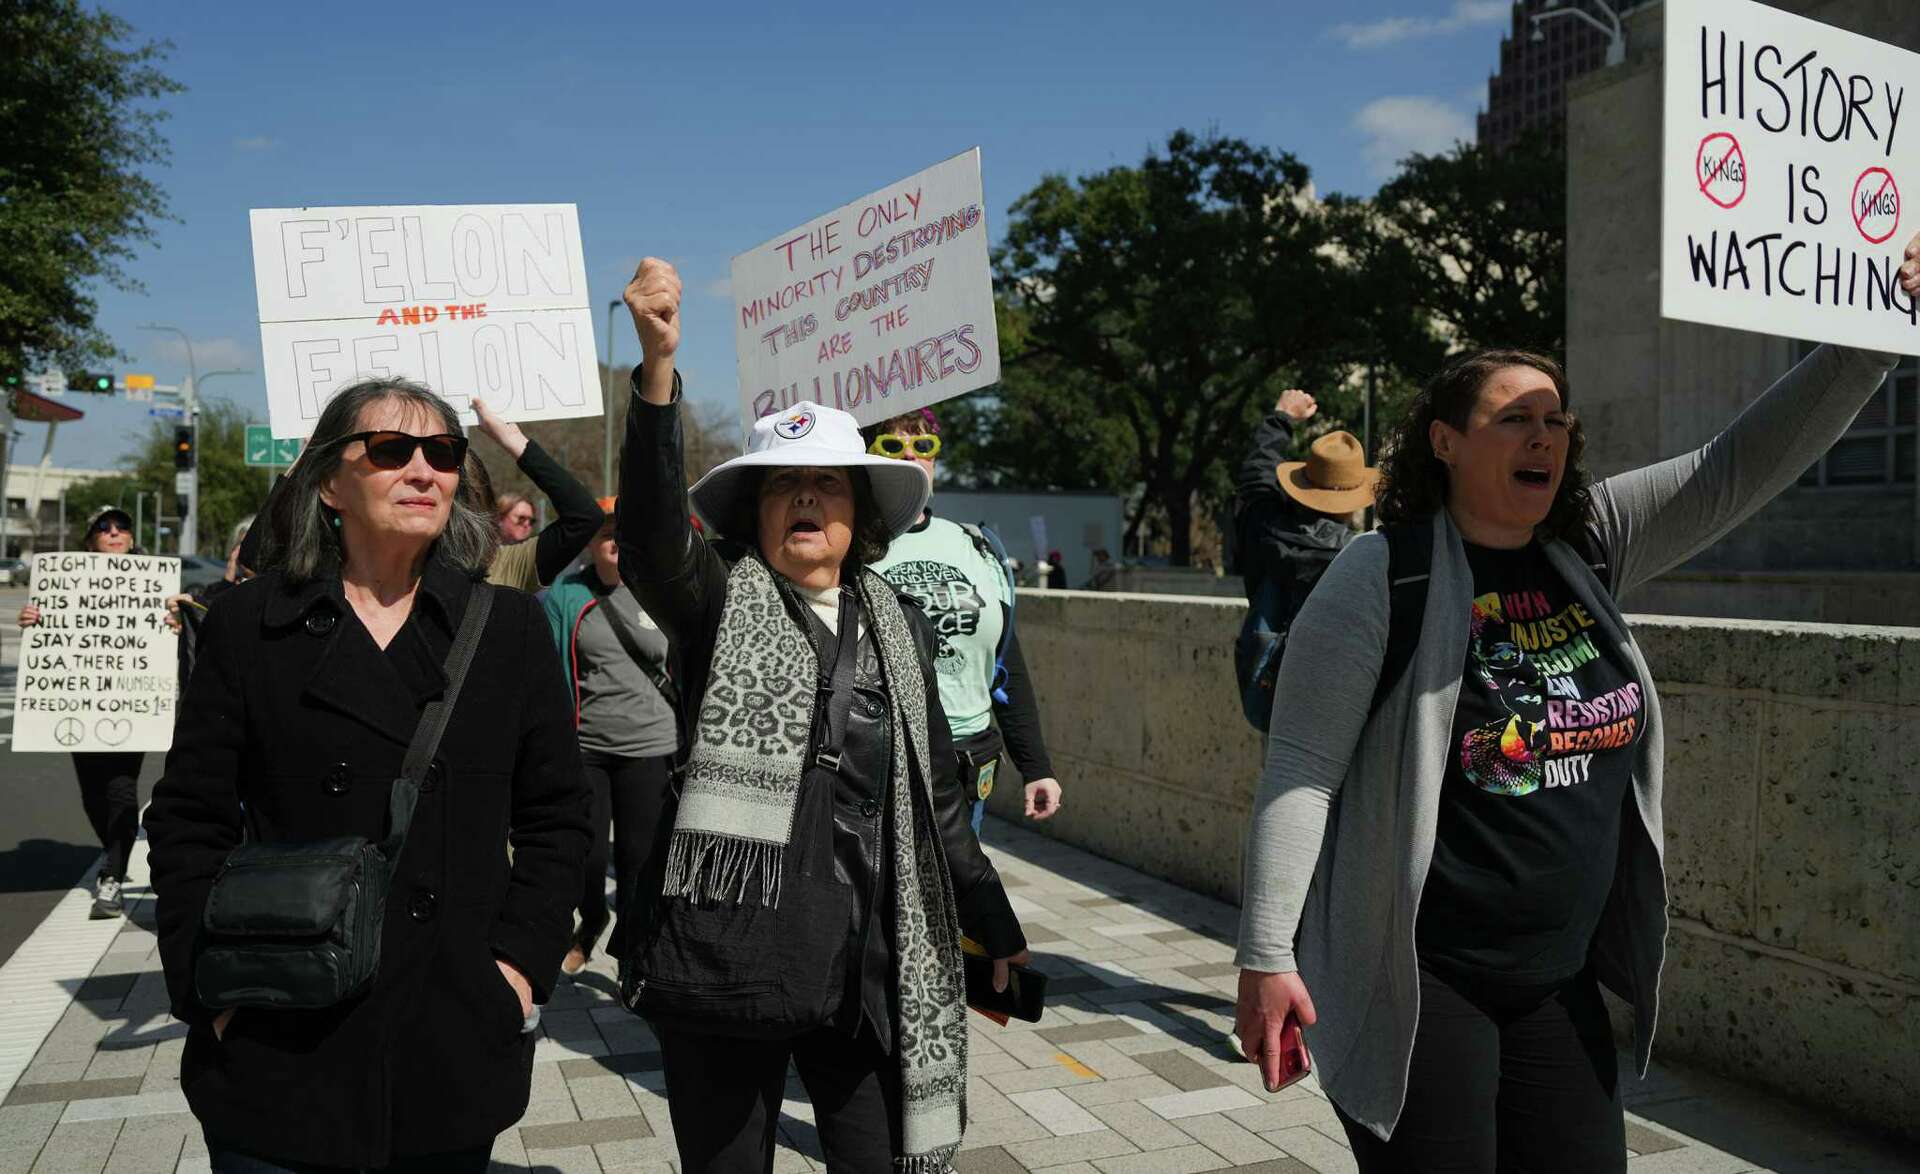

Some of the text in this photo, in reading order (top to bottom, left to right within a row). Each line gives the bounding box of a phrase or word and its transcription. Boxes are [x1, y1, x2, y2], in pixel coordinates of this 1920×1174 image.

[1702, 25, 1904, 156] HISTORY
[1703, 156, 1744, 183] KINGS
[1789, 163, 1828, 225] IS
[1860, 190, 1897, 218] KINGS
[775, 187, 922, 272] THE ONLY
[742, 204, 982, 329] MINORITY DESTROYING
[1687, 230, 1917, 326] WATCHING
[376, 303, 489, 326] AND THE
[761, 257, 935, 356] THIS COUNTRY
[817, 305, 909, 363] ARE THE
[38, 556, 180, 574] RIGHT NOW MY
[38, 577, 163, 593] ONLY HOPE IS
[76, 615, 110, 629] END
[117, 615, 136, 629] IN
[145, 612, 158, 630] 4
[30, 633, 147, 649] STAY STRONG
[73, 654, 124, 671] THERE
[133, 656, 148, 670] IS
[25, 676, 90, 692] POWER
[96, 676, 112, 692] IN
[21, 697, 91, 712] FREEDOM
[97, 699, 150, 713] COMES
[1547, 682, 1640, 728] RESISTANC
[1544, 753, 1593, 788] DUTY
